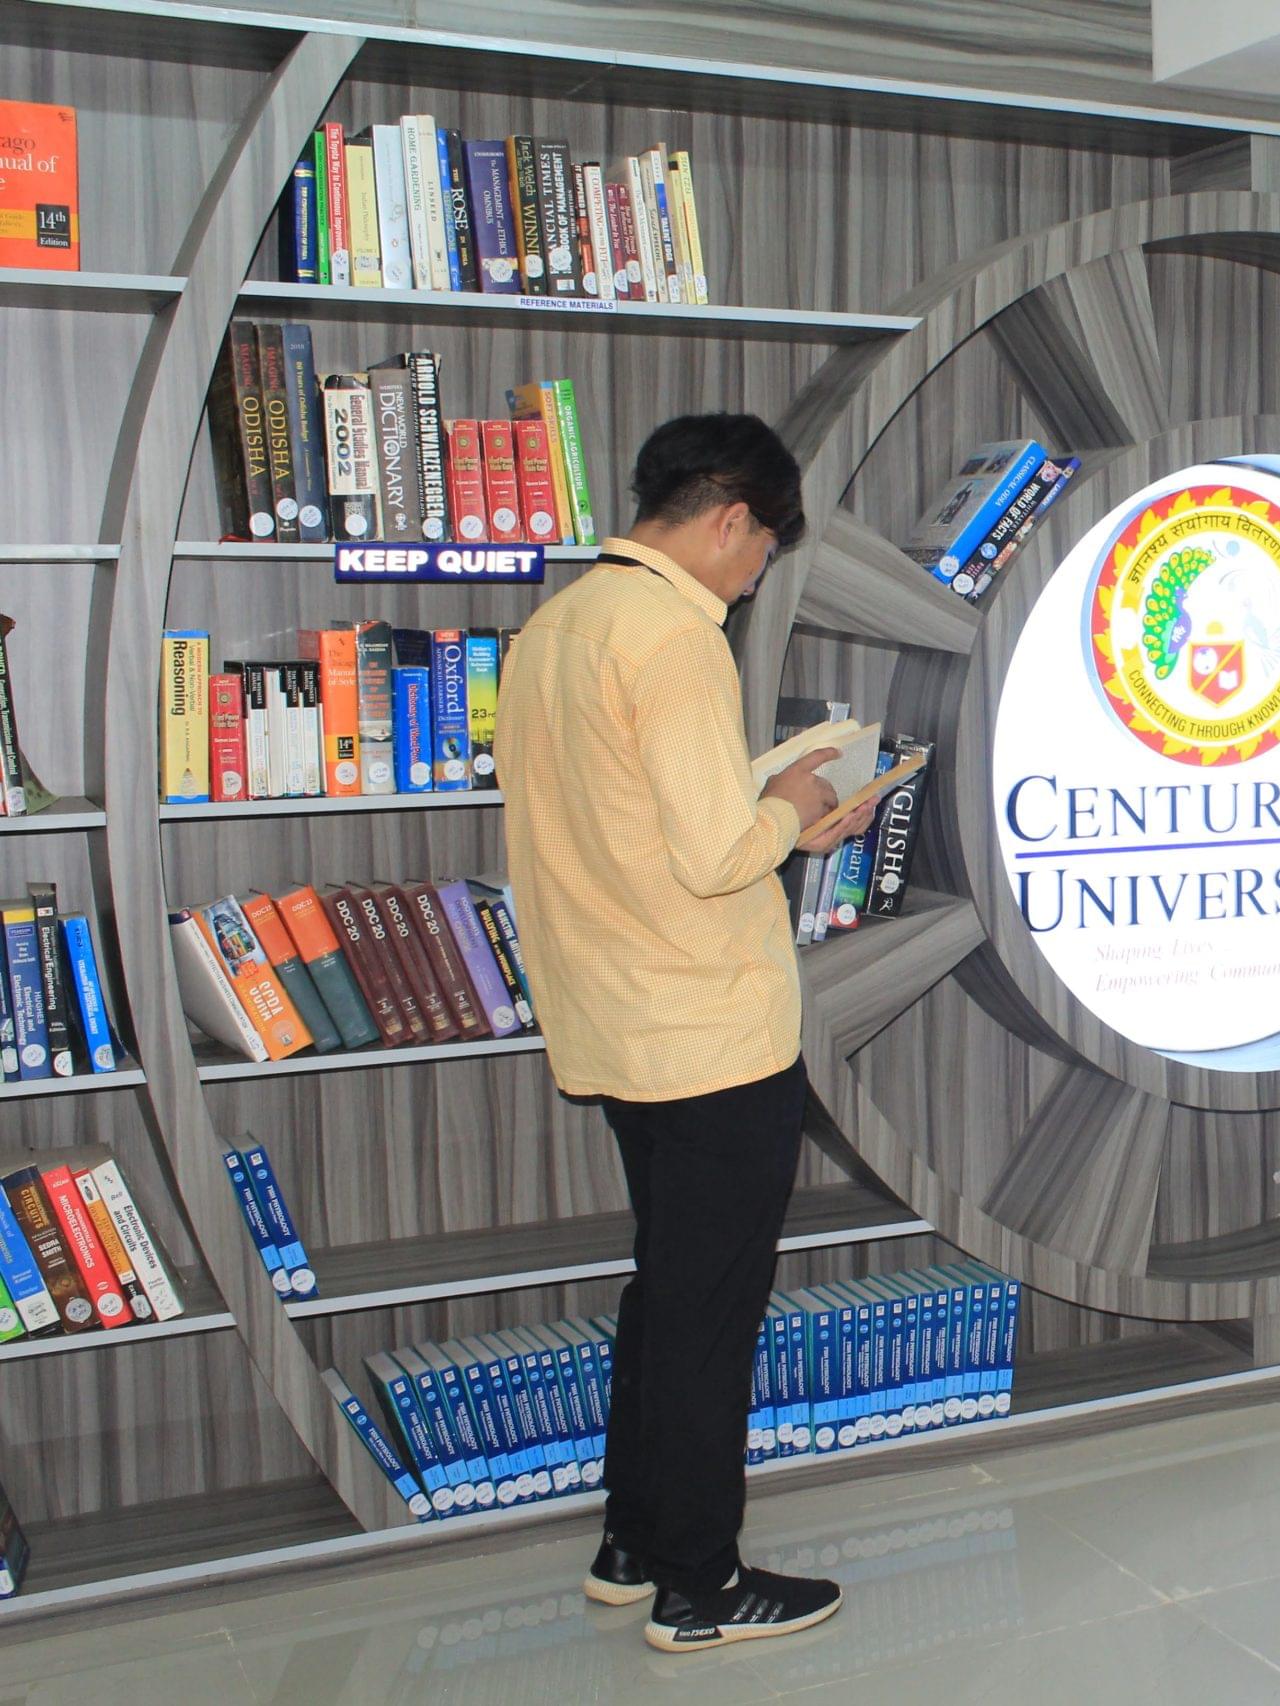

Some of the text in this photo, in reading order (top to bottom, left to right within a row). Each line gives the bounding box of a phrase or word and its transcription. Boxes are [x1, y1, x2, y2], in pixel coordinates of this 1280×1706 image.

[37, 156, 58, 174] of
[410, 156, 421, 210] GARDENING
[541, 154, 552, 196] TIMES
[553, 152, 567, 209] MANAGEMENT
[452, 188, 469, 230] ROSE
[484, 191, 493, 224] OMNIBUS
[494, 169, 504, 220] MANAGEMENT
[524, 204, 540, 256] WINNI
[520, 298, 614, 310] REFERENCE MATERIALS
[243, 397, 266, 477] ODISHA
[269, 400, 290, 480] ODISHA
[335, 408, 351, 477] 2002
[394, 391, 407, 448] NEW WORLD
[415, 358, 445, 518] ARNOLD SCHWARZENEGGER
[379, 393, 404, 508] DICTIONARY
[564, 405, 584, 491] ORGANIC AGRICULTURE
[992, 483, 1041, 540] WORLD OF FACTS
[338, 549, 538, 574] KEEP QUIET
[171, 640, 188, 716] Reasoning
[444, 645, 465, 714] Oxford
[1128, 669, 1187, 733] CONNECTING
[1189, 721, 1245, 738] THROUGH
[336, 900, 360, 941] DDC 20
[362, 899, 385, 940] DDC 20
[386, 896, 409, 938] DDC 20
[417, 894, 440, 935] DDC 20
[42, 927, 56, 1010] Electrical Engineering
[1095, 968, 1200, 994] Empowering
[13, 975, 27, 1045] Electronic Technology
[23, 987, 33, 1017] Electrical
[35, 991, 44, 1024] HUGHES
[20, 1189, 43, 1229] CIRCUITS
[58, 1194, 95, 1269] MICROELECTRONICS
[114, 1210, 137, 1253] and Circuits
[41, 1247, 62, 1258] SMITH
[123, 1205, 157, 1269] Electronic Devices
